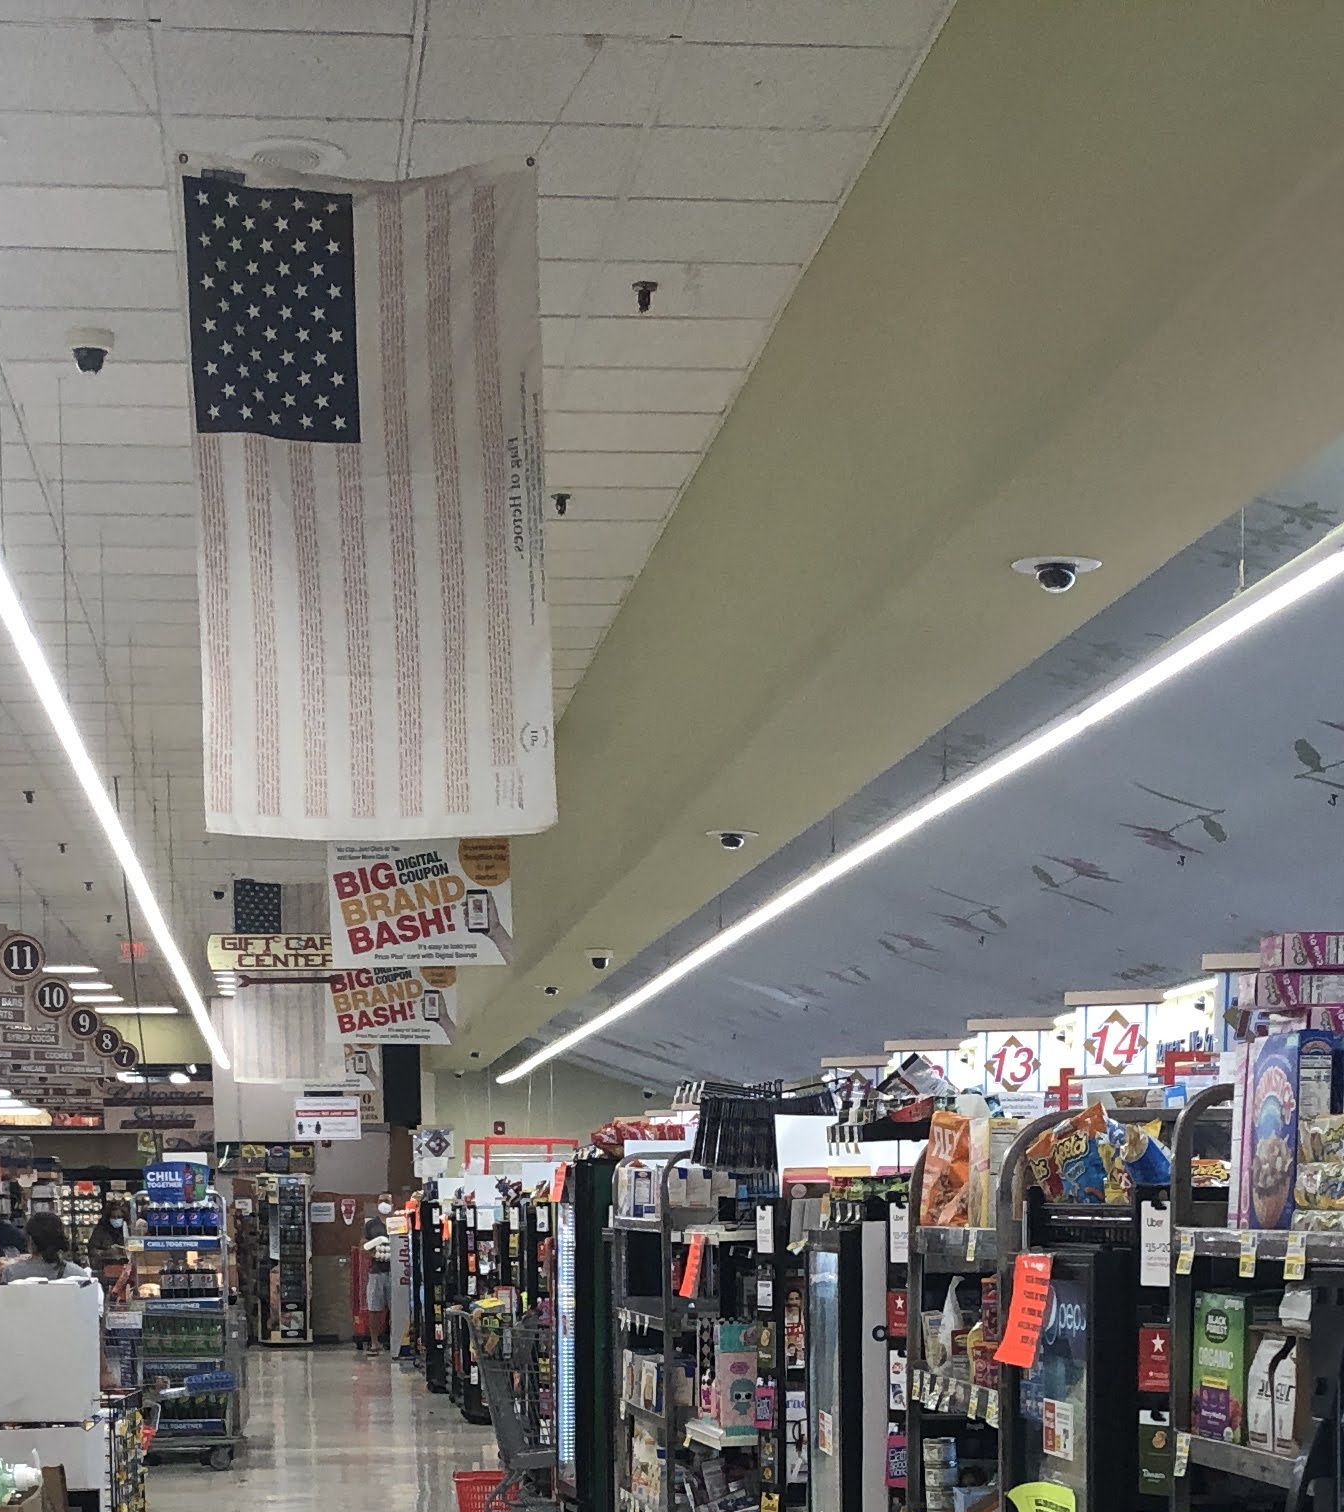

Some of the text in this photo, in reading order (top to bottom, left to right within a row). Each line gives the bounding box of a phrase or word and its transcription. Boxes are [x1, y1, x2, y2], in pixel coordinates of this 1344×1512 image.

[394, 850, 443, 872] DIGITAL
[333, 862, 398, 900] BIG
[398, 862, 449, 885] COUPON
[340, 874, 466, 927] BRAND
[347, 905, 456, 955] BASH!
[221, 936, 280, 951] GIFT
[9, 945, 34, 971] 11
[330, 967, 374, 994] BIG
[375, 971, 413, 986] COUPON
[42, 985, 65, 1009] 10
[334, 979, 423, 1014] BRAND
[79, 1013, 90, 1033] 9
[336, 1000, 416, 1034] BASH!
[102, 1033, 112, 1051] 8
[1091, 1023, 1142, 1065] 14
[120, 1050, 130, 1064] 7
[991, 1047, 1036, 1084] 13
[146, 1171, 183, 1182] CHILL
[146, 1181, 183, 1189] TOGETHER
[1146, 1217, 1164, 1228] Uber
[146, 1240, 199, 1248] CHILL TOGETHER
[1206, 1312, 1229, 1327] BLACK
[1197, 1346, 1235, 1370] ORGANIC
